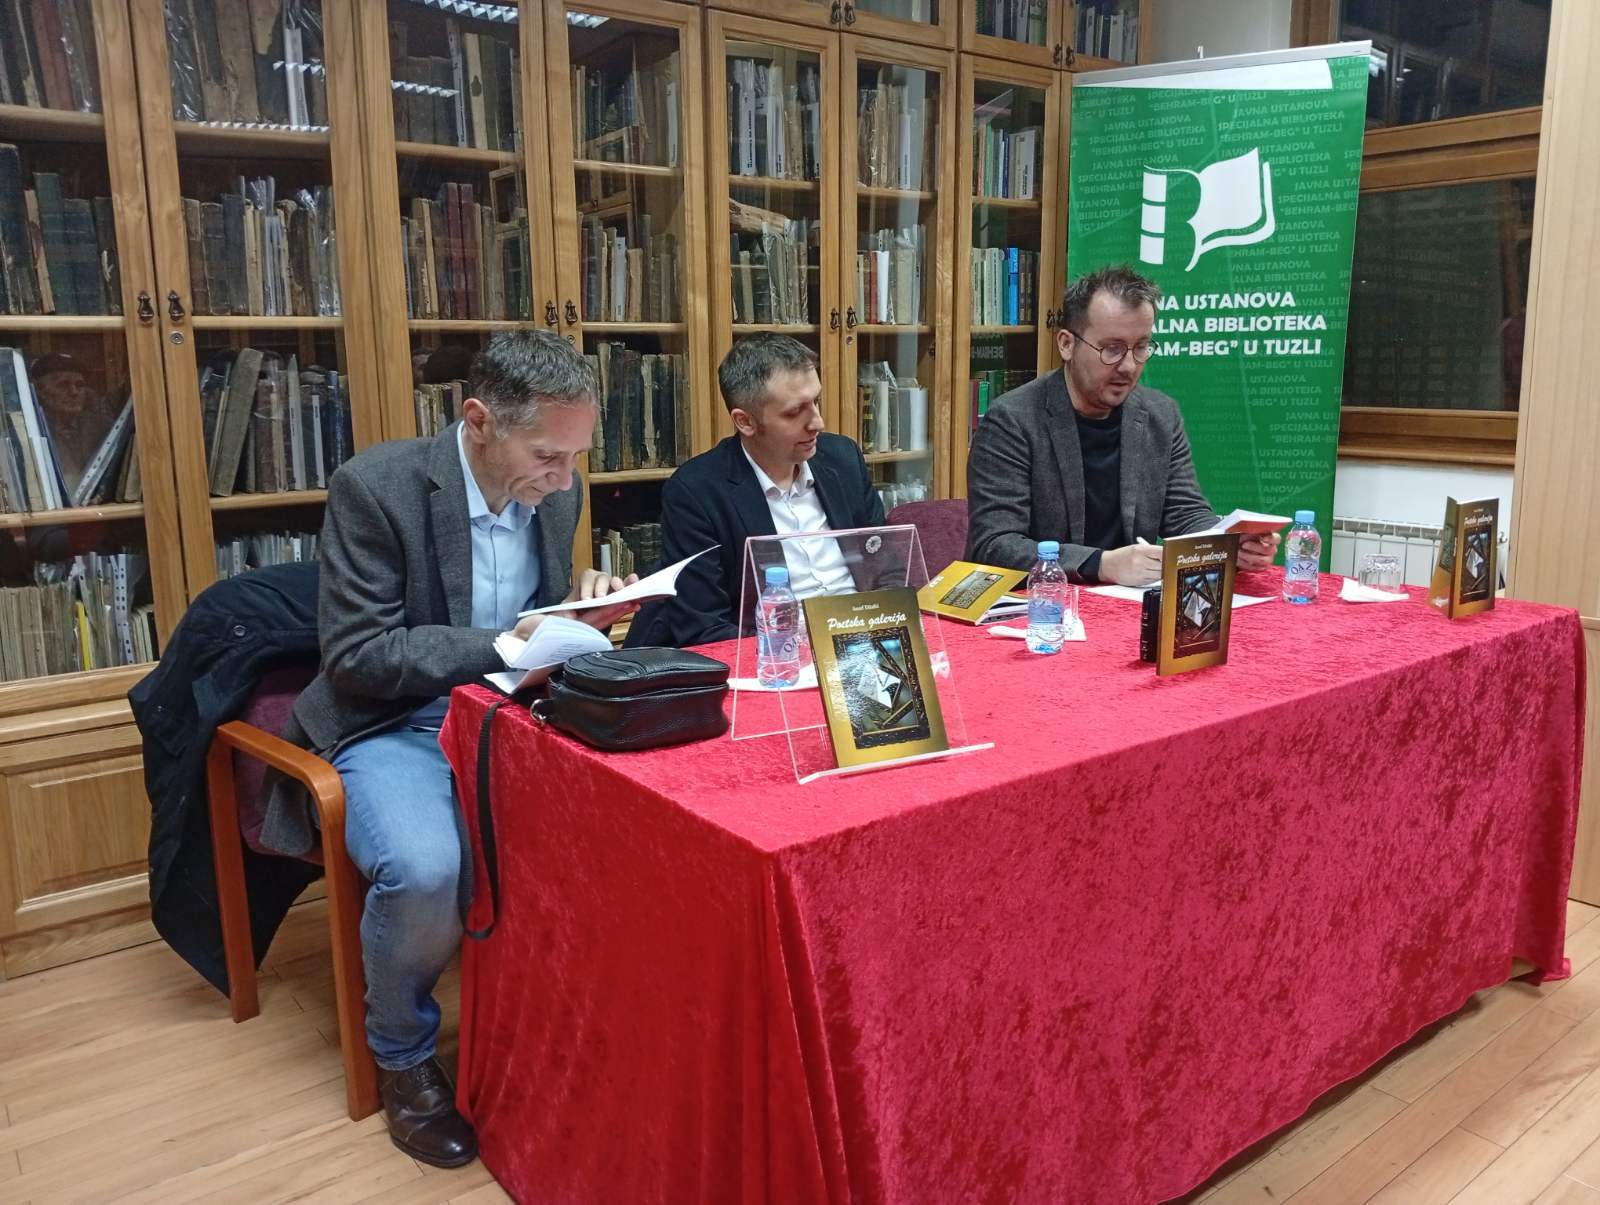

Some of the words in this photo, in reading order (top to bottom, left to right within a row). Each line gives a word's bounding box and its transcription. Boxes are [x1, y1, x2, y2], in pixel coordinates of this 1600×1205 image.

[1228, 94, 1236, 103] U
[1271, 99, 1329, 113] USTANOVA
[1138, 114, 1192, 128] USTANOVA
[1281, 110, 1345, 124] BIBLIOTEKA
[1148, 124, 1206, 138] BIBLIOTEKA
[1303, 126, 1311, 135] U
[1313, 122, 1343, 134] TUZLI
[1166, 140, 1174, 148] U
[1289, 167, 1297, 176] U
[1300, 165, 1329, 175] TUZLI
[1298, 245, 1306, 254] U
[1254, 259, 1311, 271] USTANOVA
[1263, 271, 1328, 282] BIBLIOTEKA
[1184, 291, 1297, 311] USTANOVA
[1204, 314, 1328, 333] BIBLIOTEKA
[1243, 339, 1259, 355] U
[1263, 338, 1322, 356] TUZLI
[827, 616, 865, 631] Poetska
[868, 612, 907, 629] galerija
